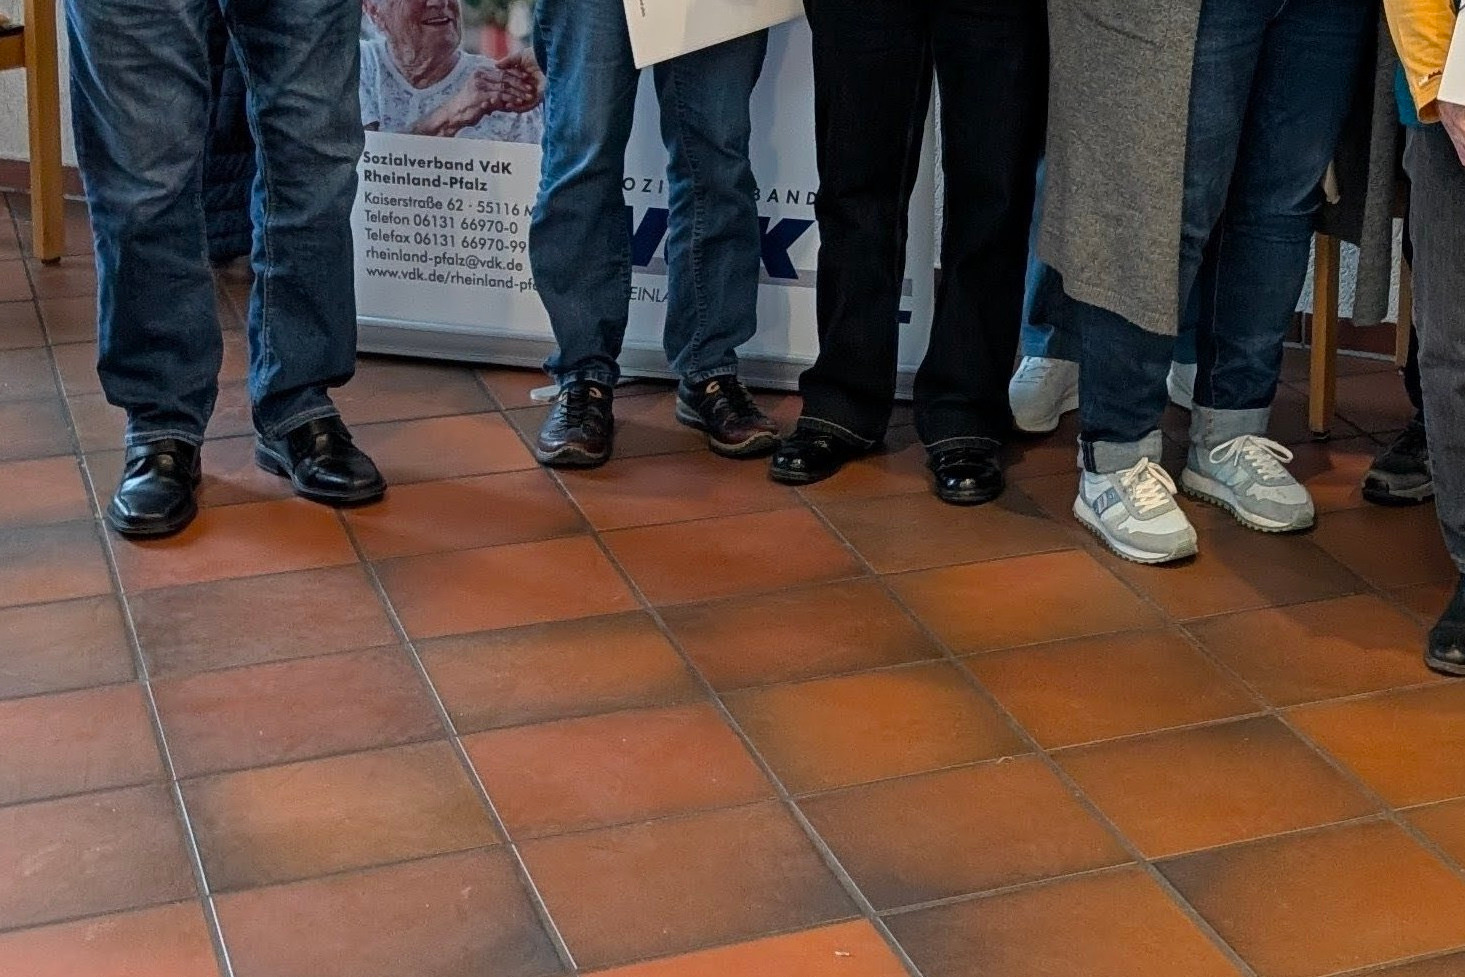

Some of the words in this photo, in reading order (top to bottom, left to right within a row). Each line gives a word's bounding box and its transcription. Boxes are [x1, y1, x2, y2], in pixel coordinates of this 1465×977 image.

[363, 151, 474, 172] Sozialverband
[479, 160, 512, 175] VdK
[364, 169, 488, 192] Rheinland-Pfalz
[364, 191, 443, 210] Kaiserstraße
[447, 197, 464, 212] 62
[477, 200, 520, 216] 55116
[365, 210, 410, 225] Telefon
[413, 213, 454, 229] 06131
[461, 217, 518, 235] 66970-0
[365, 227, 411, 244] Telefax
[414, 231, 455, 248] 06131
[461, 235, 527, 254] 66970-99
[624, 204, 816, 280] VK
[366, 245, 523, 272] rheinland-pfalz@vdk.de
[366, 267, 538, 293] www.vdk.de/rheinland-pf
